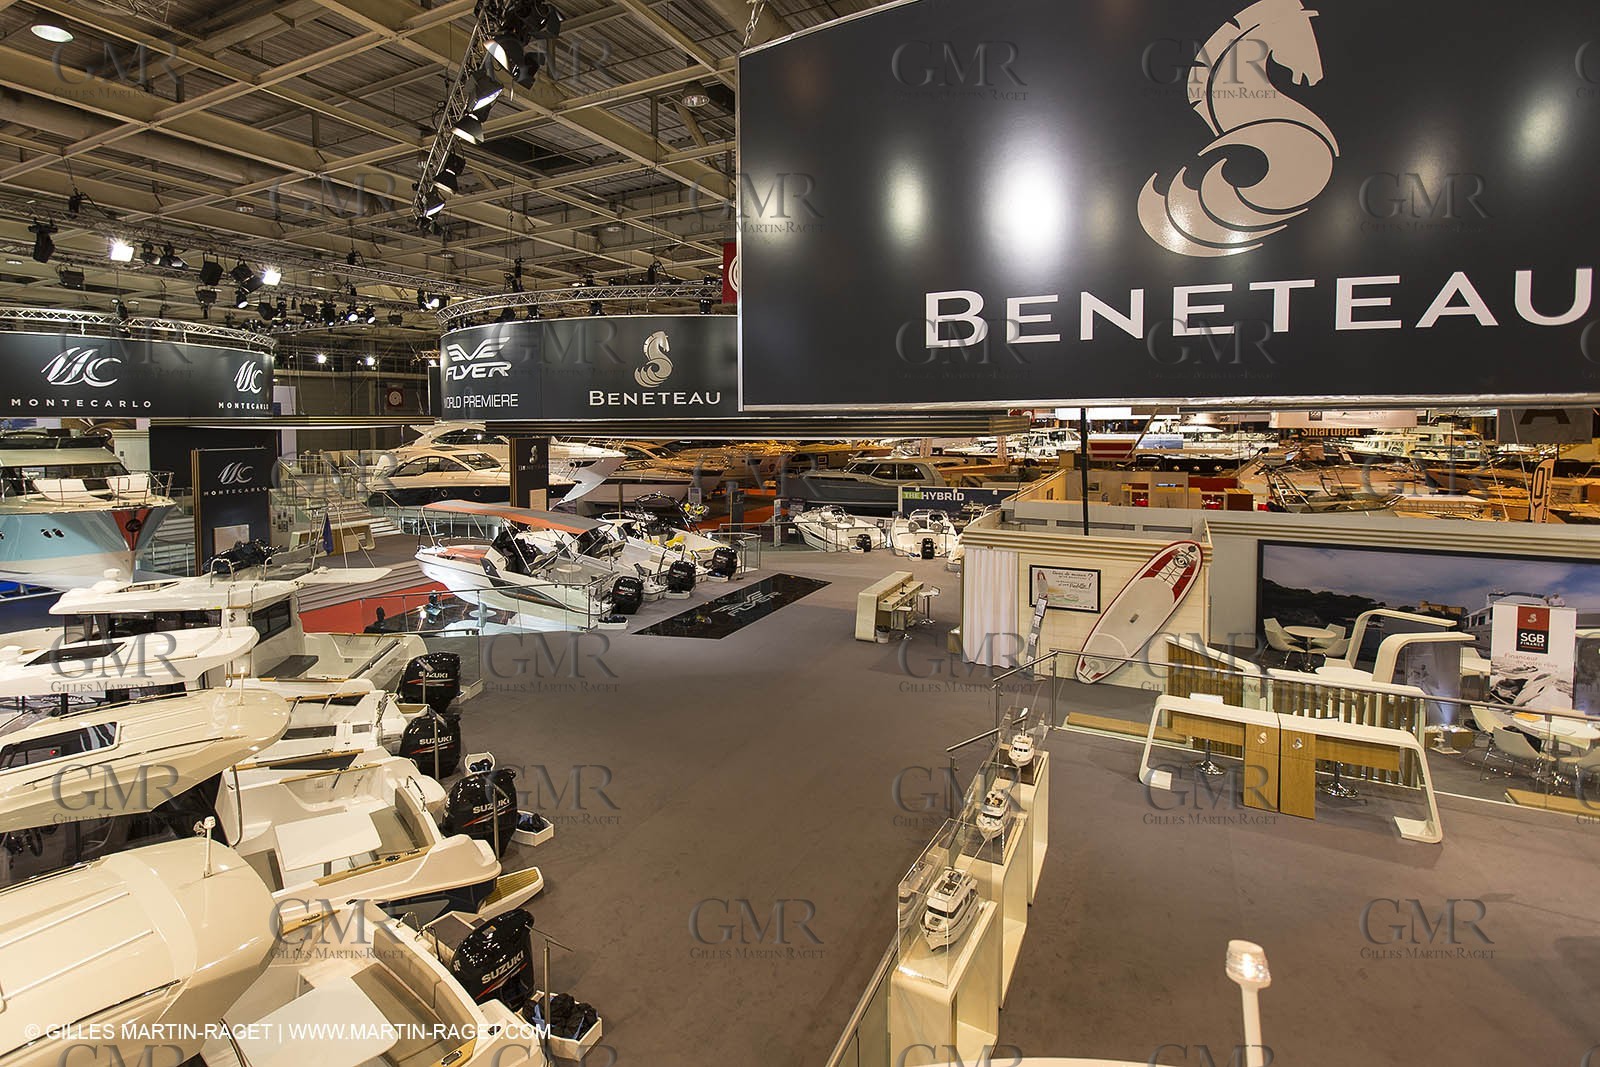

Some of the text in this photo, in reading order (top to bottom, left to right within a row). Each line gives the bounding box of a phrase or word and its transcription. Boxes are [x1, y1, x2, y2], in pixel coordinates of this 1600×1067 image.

[925, 266, 1594, 351] BENETEAU
[446, 361, 512, 382] FLYER
[11, 398, 151, 409] MONTECARLO
[463, 393, 519, 408] PREMIERE
[589, 390, 721, 406] BENETEAU
[203, 486, 267, 496] MONTECARLO
[903, 491, 965, 501] THE HYBRID
[1520, 632, 1545, 643] SGB
[418, 671, 448, 679] SUZUKI
[419, 735, 453, 745] SUZUKI
[472, 798, 510, 814] SUZUKI
[481, 950, 524, 985] SUZUKI
